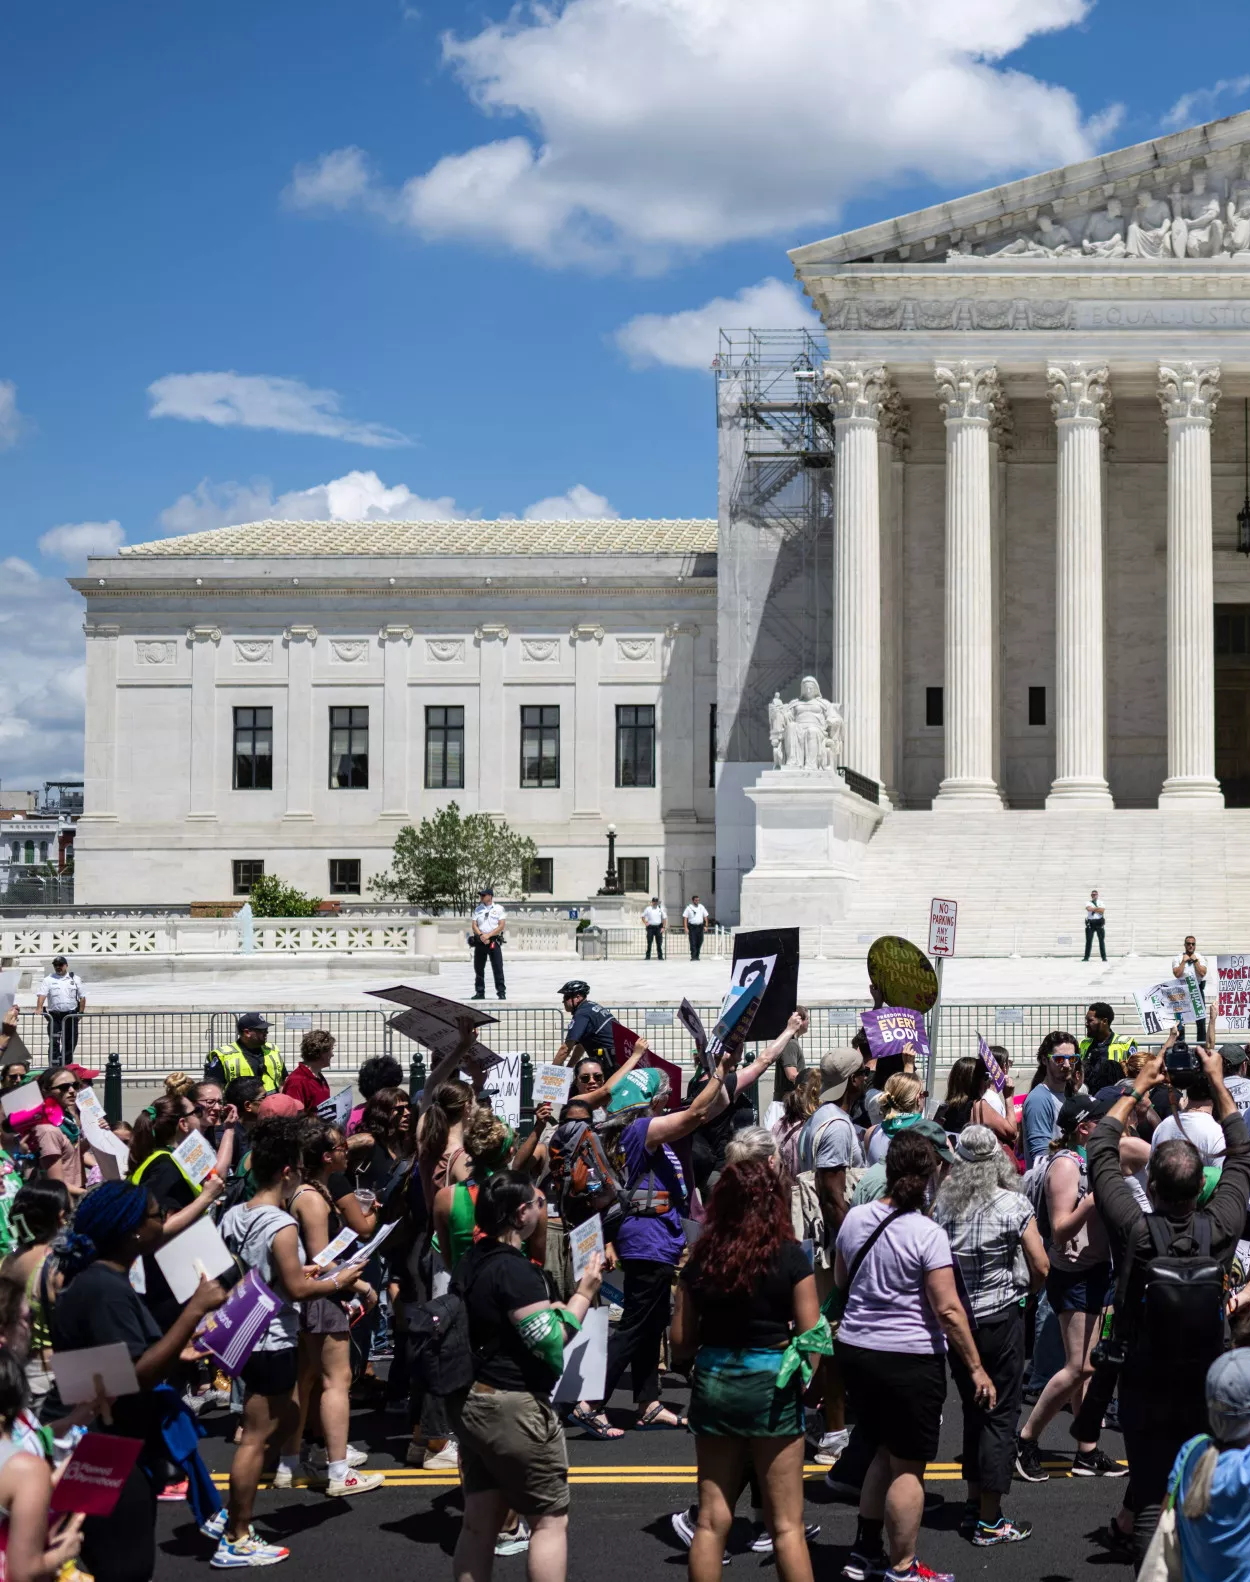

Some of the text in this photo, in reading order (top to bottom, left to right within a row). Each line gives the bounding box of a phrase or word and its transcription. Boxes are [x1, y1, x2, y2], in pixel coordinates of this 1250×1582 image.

[1091, 307, 1170, 327] EQUAL
[939, 904, 948, 914] NO
[933, 914, 954, 926] PARKING
[937, 927, 948, 935] ANY
[936, 936, 948, 944] TIME
[884, 941, 921, 961] Grow
[870, 952, 935, 982] Abortion
[1231, 956, 1244, 967] DO
[887, 968, 936, 993] Power
[1219, 980, 1242, 991] HAVE
[1190, 988, 1203, 1009] with
[1218, 1004, 1247, 1016] BEAT
[878, 1018, 916, 1031] EVERY
[1226, 1017, 1246, 1029] YET
[882, 1028, 918, 1043] BODY
